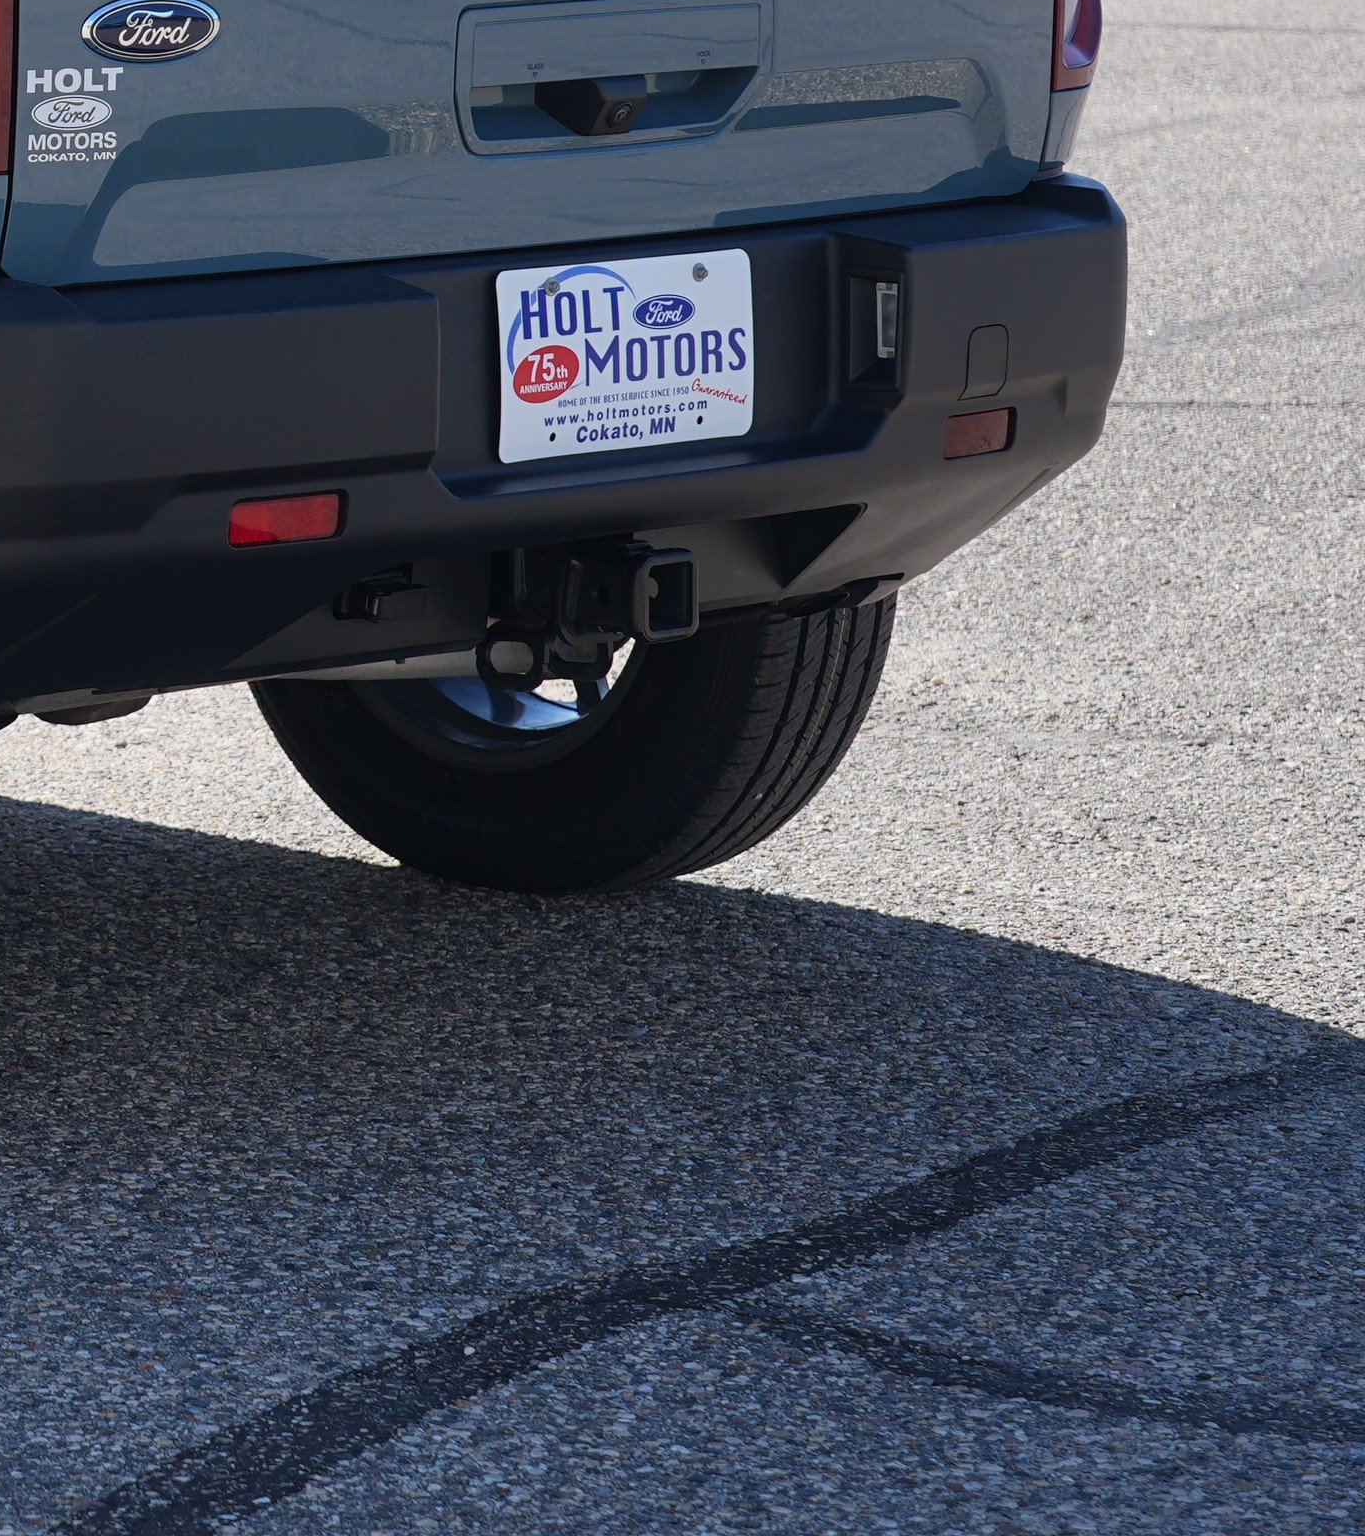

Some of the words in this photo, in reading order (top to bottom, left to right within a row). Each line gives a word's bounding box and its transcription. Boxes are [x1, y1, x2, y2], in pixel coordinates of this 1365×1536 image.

[118, 10, 192, 47] Ford
[696, 50, 711, 58] DOOR
[527, 63, 544, 71] GLASS
[26, 66, 124, 94] HOLT
[48, 100, 96, 123] Ford
[27, 131, 117, 151] MOTORS
[27, 152, 89, 163] COKATO,
[93, 151, 117, 161] MN
[520, 286, 624, 339] HOLT
[645, 301, 684, 324] Ford
[527, 353, 569, 383] 75th
[585, 327, 747, 387] MOTORS
[519, 380, 568, 395] ANNIVERSARY
[557, 399, 578, 408] HOME
[579, 398, 588, 406] OF
[589, 396, 601, 404] THE
[603, 394, 619, 403] BEST
[620, 390, 649, 401] SERVICE
[650, 388, 671, 398] SINCE
[672, 386, 689, 396] 1950
[691, 378, 748, 405] Guaranteed
[544, 399, 708, 427] www.holtmotors.com
[576, 421, 644, 444] Cokato,
[650, 416, 676, 435] MN
